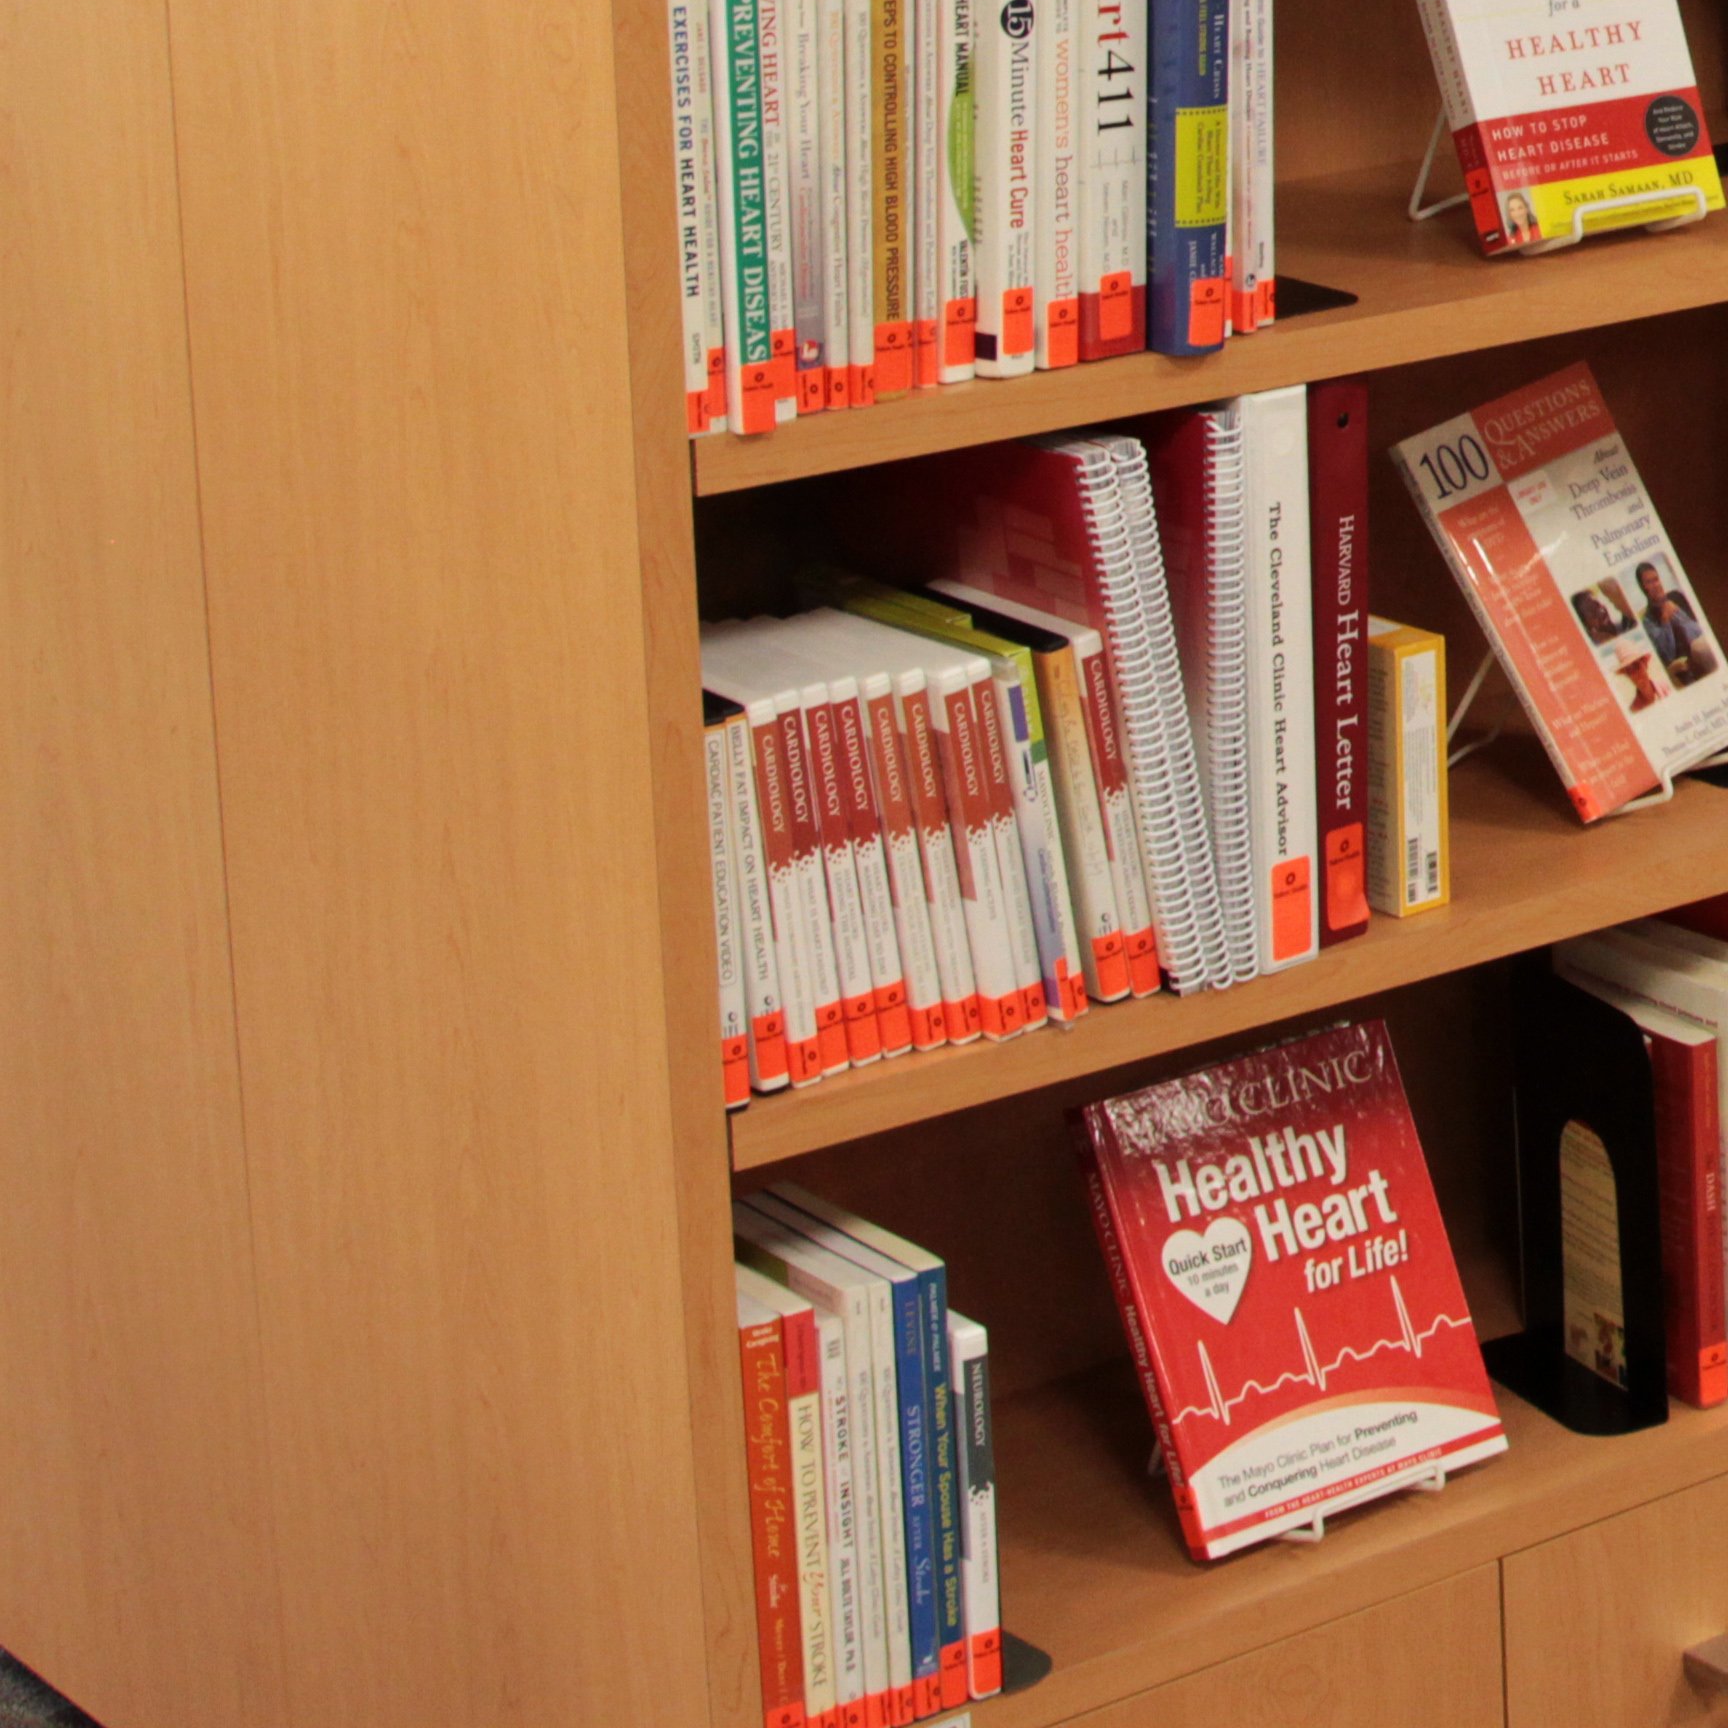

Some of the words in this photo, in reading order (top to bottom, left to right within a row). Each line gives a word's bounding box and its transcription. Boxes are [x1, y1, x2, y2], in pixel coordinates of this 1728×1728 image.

[884, 29, 897, 49] TO
[1008, 0, 1033, 36] 15
[1506, 21, 1643, 60] HEALTHY
[673, 7, 691, 108] EXERCISES
[955, 42, 969, 96] MANUAL
[1010, 41, 1029, 127] Minute
[1539, 63, 1630, 96] HEART
[678, 116, 693, 151] FOR
[884, 53, 898, 152] CONTROLLING
[1492, 125, 1524, 141] HOW
[1529, 121, 1548, 135] TO
[1553, 115, 1587, 131] STOP
[885, 157, 898, 190] HIGH
[1010, 129, 1029, 183] Heart
[1497, 143, 1544, 162] HEART
[1550, 133, 1609, 153] DISEASE
[680, 159, 696, 217] HEART
[740, 167, 762, 257] HEART
[885, 196, 898, 243] BLOOD
[1010, 187, 1029, 229] Cure
[683, 226, 700, 297] HEALTH
[886, 248, 899, 319] PRESSURE
[742, 267, 767, 363] DISEAS
[1269, 502, 1280, 541] The
[1337, 515, 1354, 606] HARVARD
[1269, 547, 1284, 647] Cleveland
[1273, 653, 1287, 711] Clinic
[1336, 609, 1358, 705] Heart
[980, 690, 1004, 784] CARDIOLOGY
[1090, 660, 1117, 760] CARDIOLOGY
[1274, 718, 1287, 774] Heart
[762, 734, 784, 833] CARDIOLOGY
[783, 716, 808, 822] CARDIOLOGY
[814, 710, 840, 817] CARDIOLOGY
[842, 705, 868, 811] CARDIOLOGY
[877, 707, 902, 803] CARDIOLOGY
[912, 703, 936, 798] CARDIOLOGY
[954, 702, 979, 796] CARDIOLOGY
[1336, 714, 1358, 809] Letter
[1275, 782, 1288, 856] Advisor
[1157, 1124, 1346, 1223] Healthy
[1254, 1169, 1396, 1262] Heart
[1168, 1249, 1210, 1276] Quick
[1212, 1237, 1247, 1263] Start
[1304, 1256, 1344, 1293] for
[1347, 1230, 1408, 1279] Life!
[836, 1396, 849, 1460] STROKE
[906, 1406, 925, 1506] STRONGER
[1219, 1472, 1241, 1490] The
[1243, 1460, 1276, 1484] Mayo
[1277, 1449, 1307, 1470] Clinic
[1309, 1440, 1335, 1458] Plan
[1337, 1432, 1352, 1446] for
[1354, 1410, 1418, 1444] Preventing
[1224, 1489, 1246, 1507] and
[1248, 1465, 1318, 1499] Conquering
[1319, 1455, 1350, 1474] Heart
[1352, 1438, 1397, 1463] Disease
[841, 1482, 854, 1550] INSIGHT
